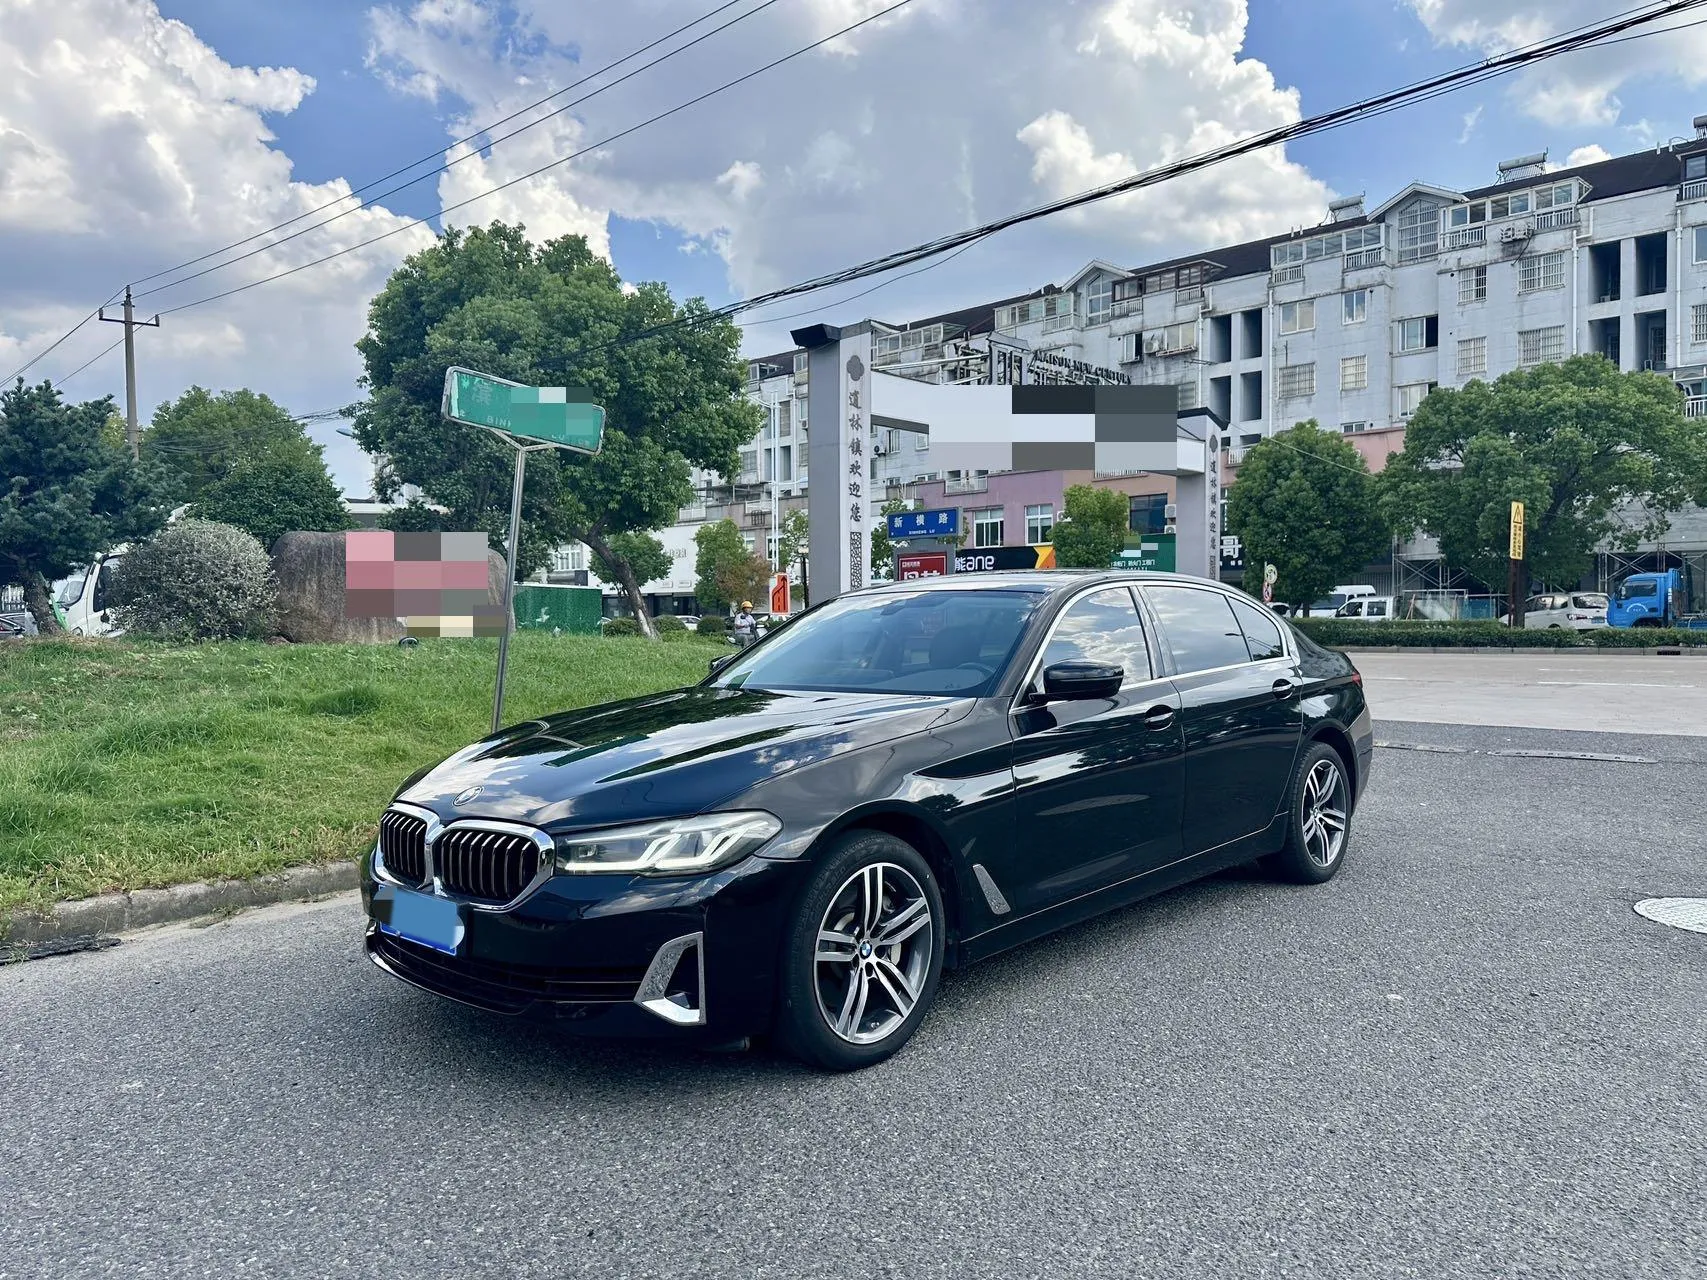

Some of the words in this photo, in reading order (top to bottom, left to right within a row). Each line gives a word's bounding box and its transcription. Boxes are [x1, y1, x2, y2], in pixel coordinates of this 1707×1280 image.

[1073, 359, 1094, 374] NEW
[848, 390, 863, 522] 道林镇欢迎您
